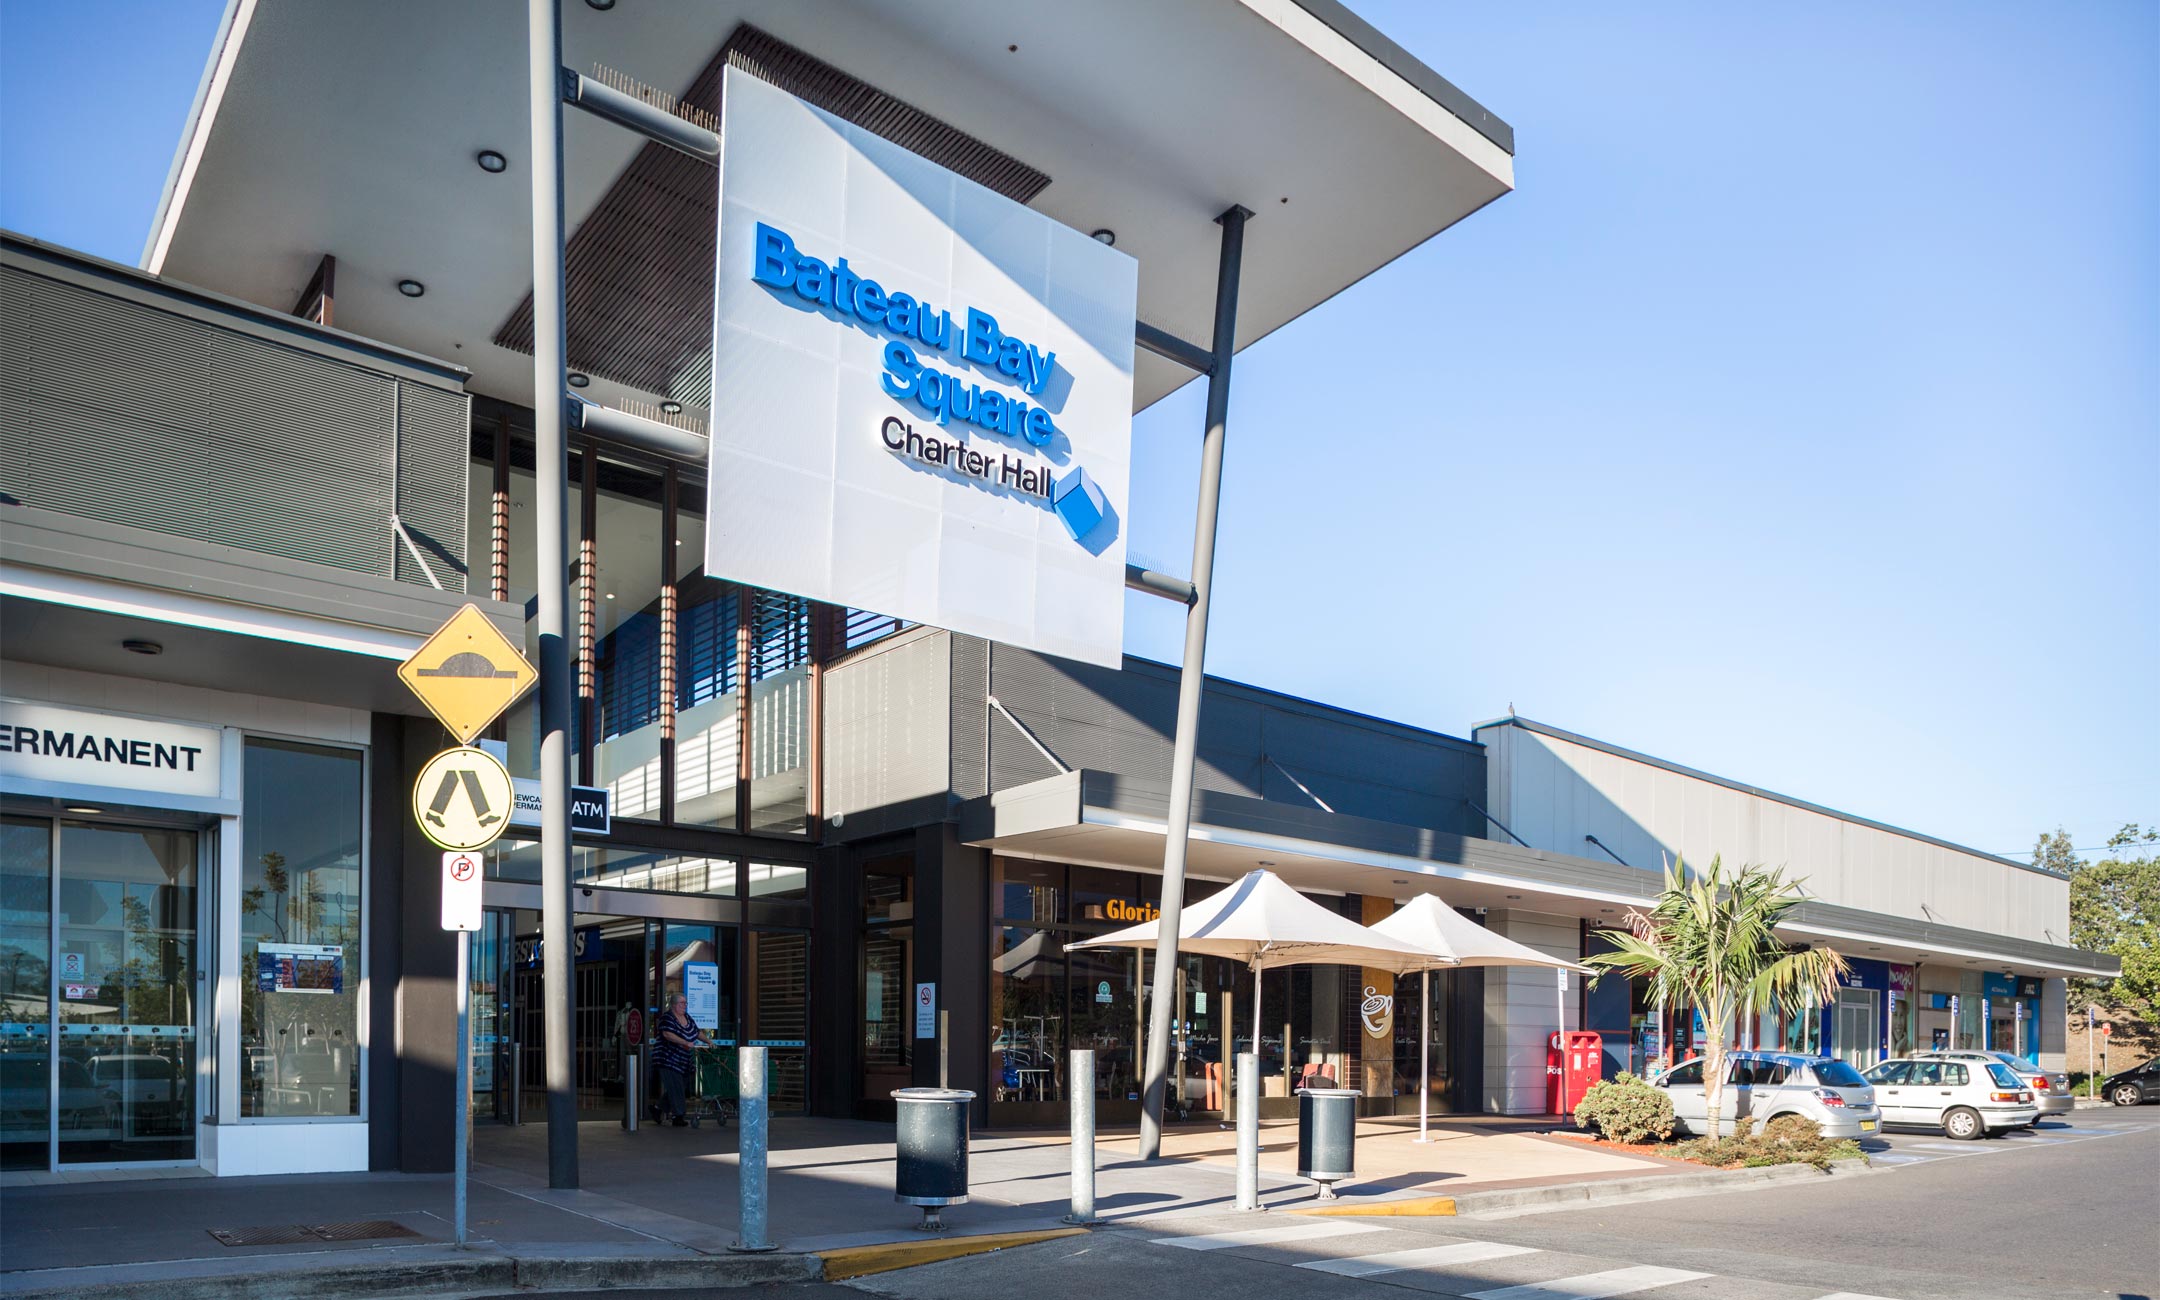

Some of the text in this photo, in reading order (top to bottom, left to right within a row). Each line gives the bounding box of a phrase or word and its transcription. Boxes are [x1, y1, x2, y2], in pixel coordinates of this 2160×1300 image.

[752, 221, 1057, 395] Bateau Bay
[880, 340, 1056, 448] Square
[881, 415, 1052, 499] Charter Hall
[514, 793, 542, 804] EWCA
[572, 801, 604, 818] ATM
[1106, 898, 1161, 922] Gloria
[1547, 1067, 1566, 1075] POS
